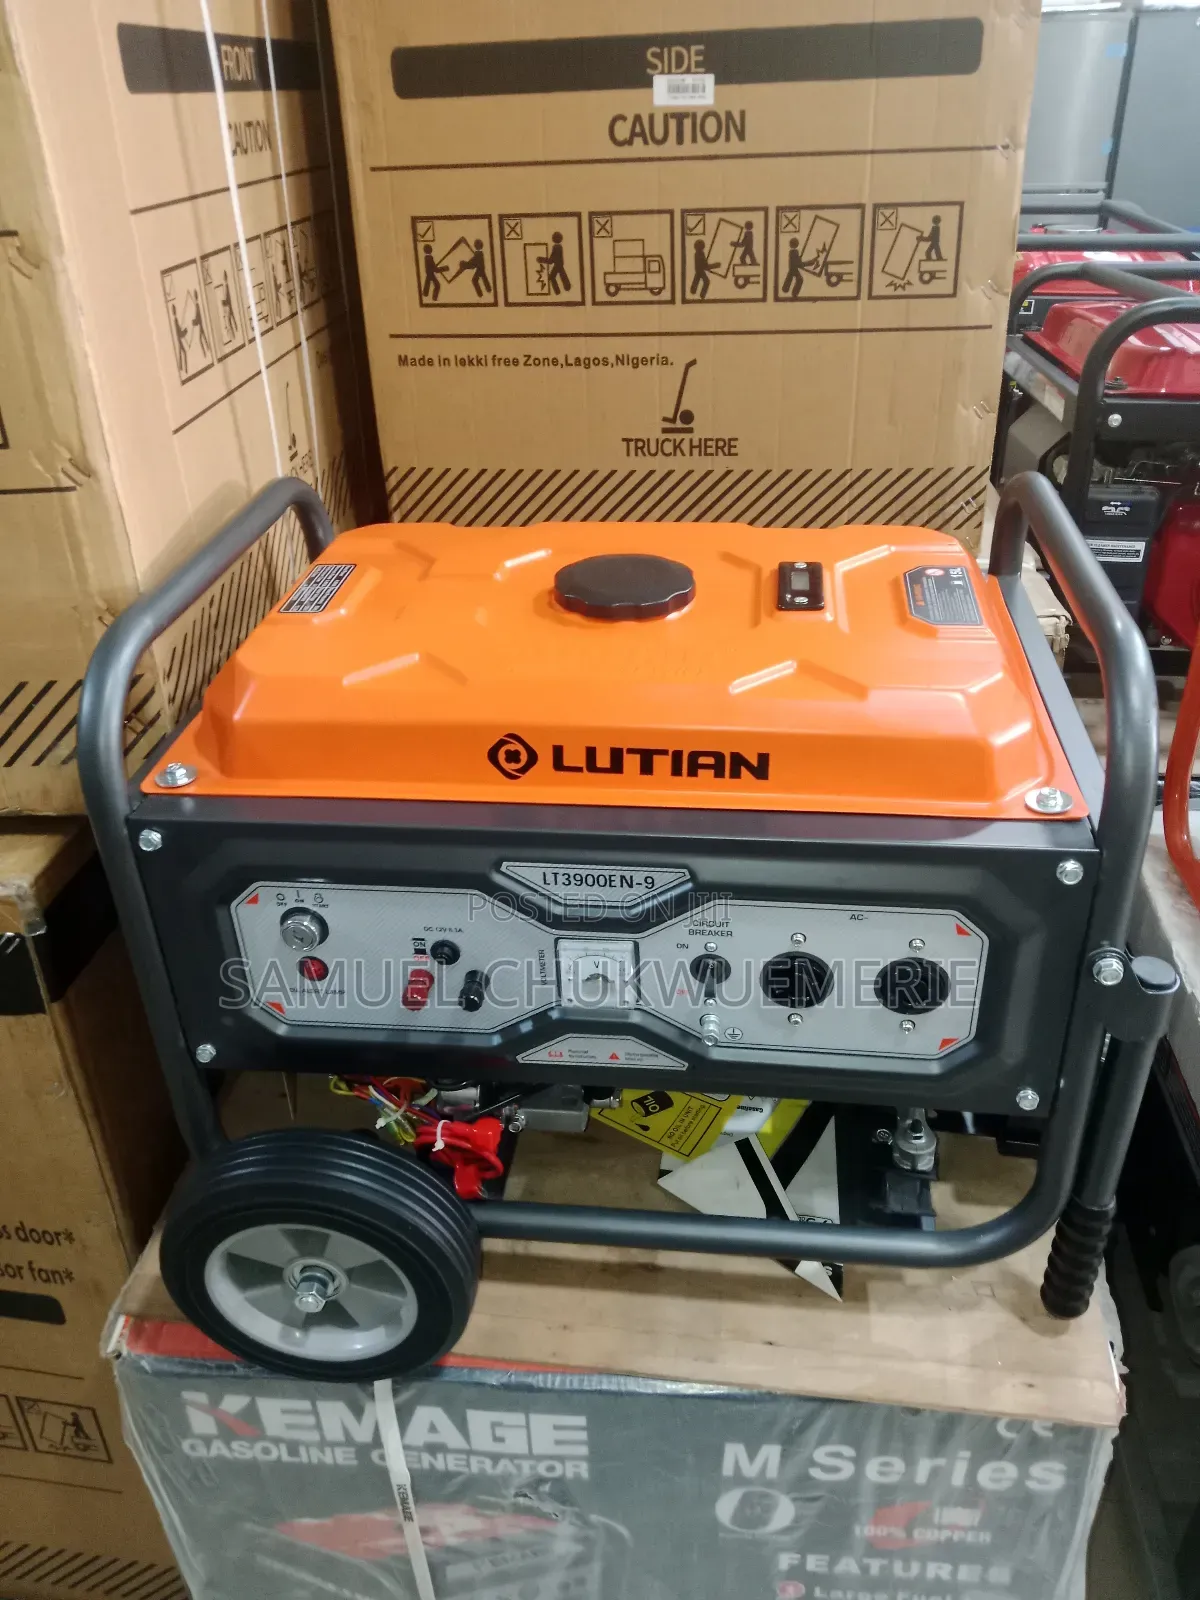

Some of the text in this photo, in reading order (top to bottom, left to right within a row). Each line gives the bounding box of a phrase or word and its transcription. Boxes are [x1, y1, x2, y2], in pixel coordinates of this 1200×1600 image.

[221, 44, 256, 80] FRONT
[646, 45, 705, 74] SIDE
[608, 109, 746, 147] CAUTION
[398, 354, 434, 367] Made
[438, 354, 451, 367] in
[491, 354, 520, 367] free
[621, 437, 739, 457] TRUCK HERE
[552, 744, 770, 780] LUTIAN
[543, 871, 655, 889] LT3900EN-9
[688, 928, 733, 937] BREAKER
[693, 919, 730, 928] CIRCUIT
[538, 949, 548, 986] VOLTMETER
[593, 960, 600, 969] V
[181, 1390, 589, 1455] KEMAGE
[180, 1437, 359, 1466] GASOLINE
[722, 1443, 1068, 1491] M Series
[912, 1527, 993, 1543] COPPER
